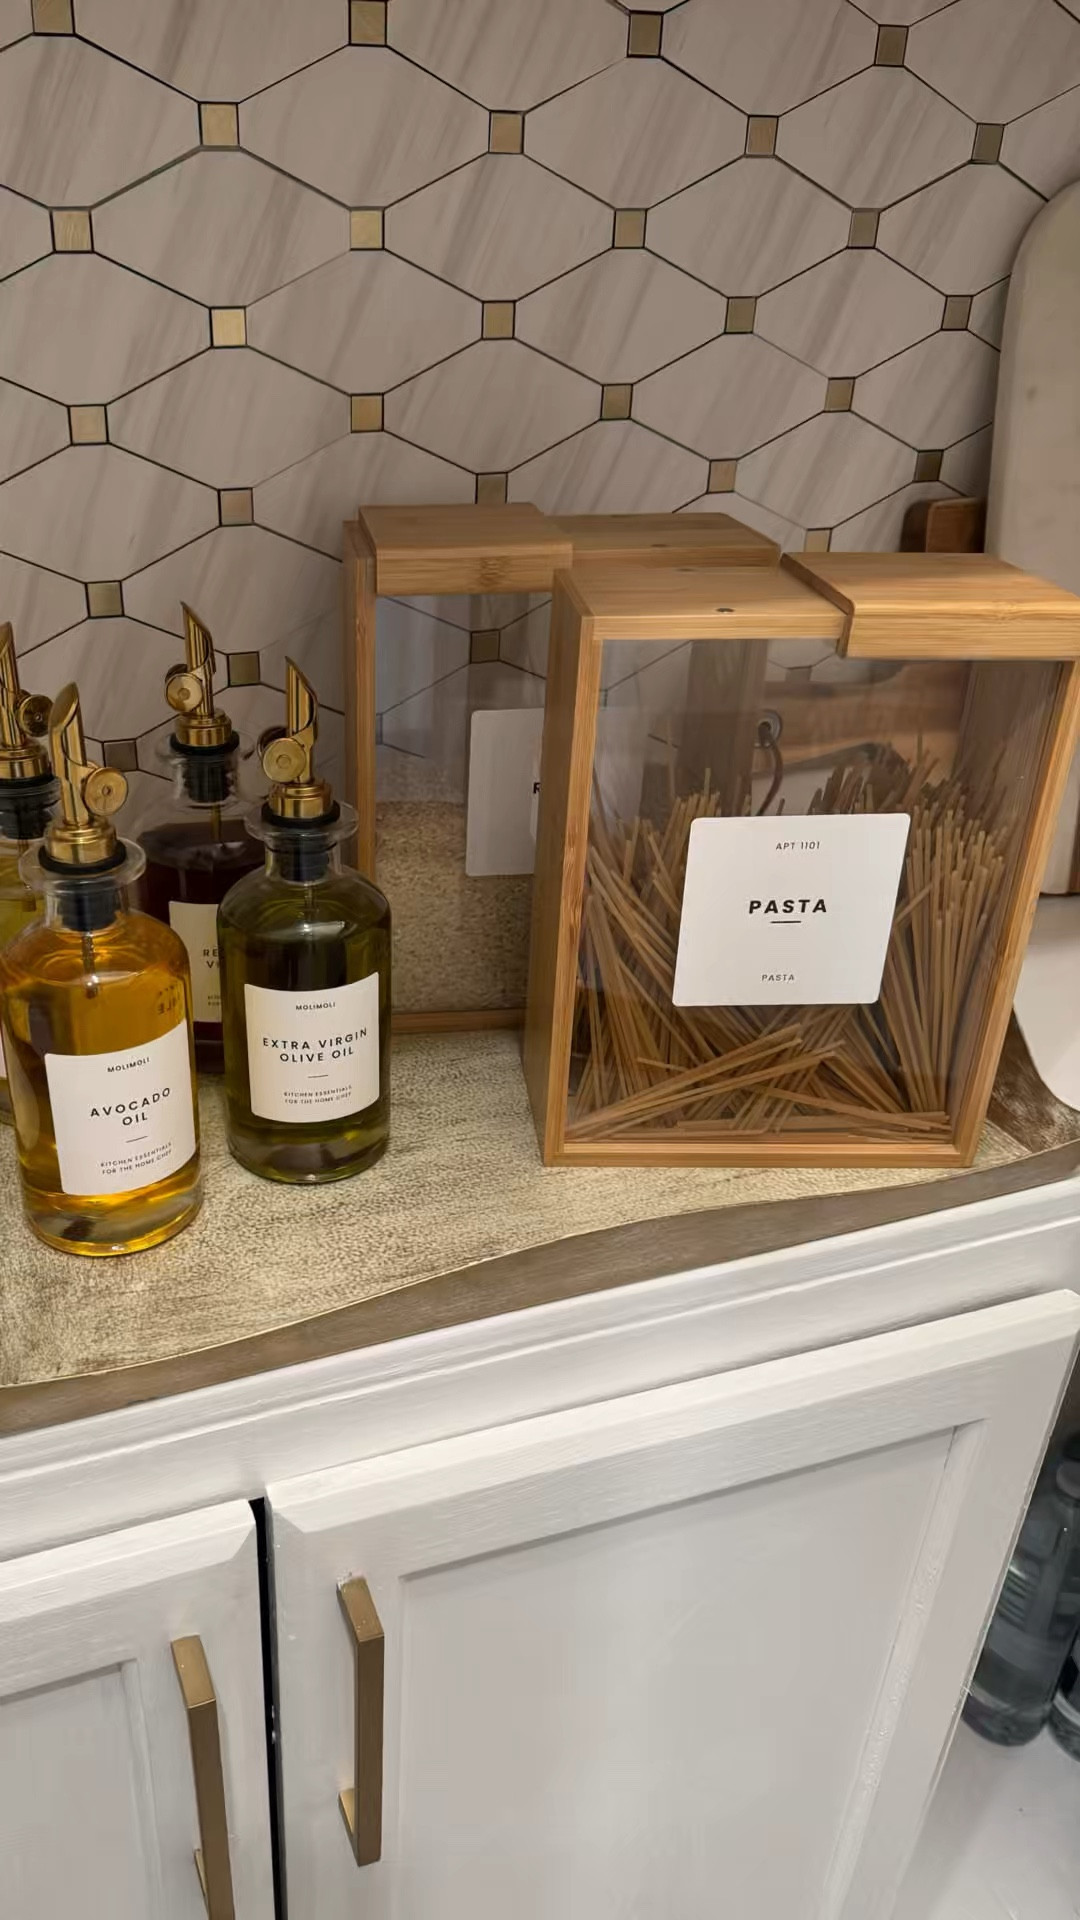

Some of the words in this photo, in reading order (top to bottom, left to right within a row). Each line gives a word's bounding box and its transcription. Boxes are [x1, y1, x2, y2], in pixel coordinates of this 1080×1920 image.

[775, 842, 796, 851] APT
[800, 841, 820, 850] 1101
[748, 898, 827, 914] PASTA
[761, 974, 795, 982] PASTA
[295, 1001, 336, 1011] MOLIMOLI
[263, 1037, 310, 1050] EXTRA
[318, 1027, 367, 1049] VIRGIN
[279, 1052, 324, 1063] OLIVE
[331, 1046, 354, 1060] OIL
[107, 1056, 150, 1073] MOLIMOLI
[90, 1087, 170, 1118] AVOCADO
[122, 1112, 148, 1126] OIL
[100, 1157, 133, 1168] KITCHEN
[102, 1167, 117, 1175] FOR
[120, 1164, 132, 1173] THE
[135, 1157, 155, 1168] HOME
